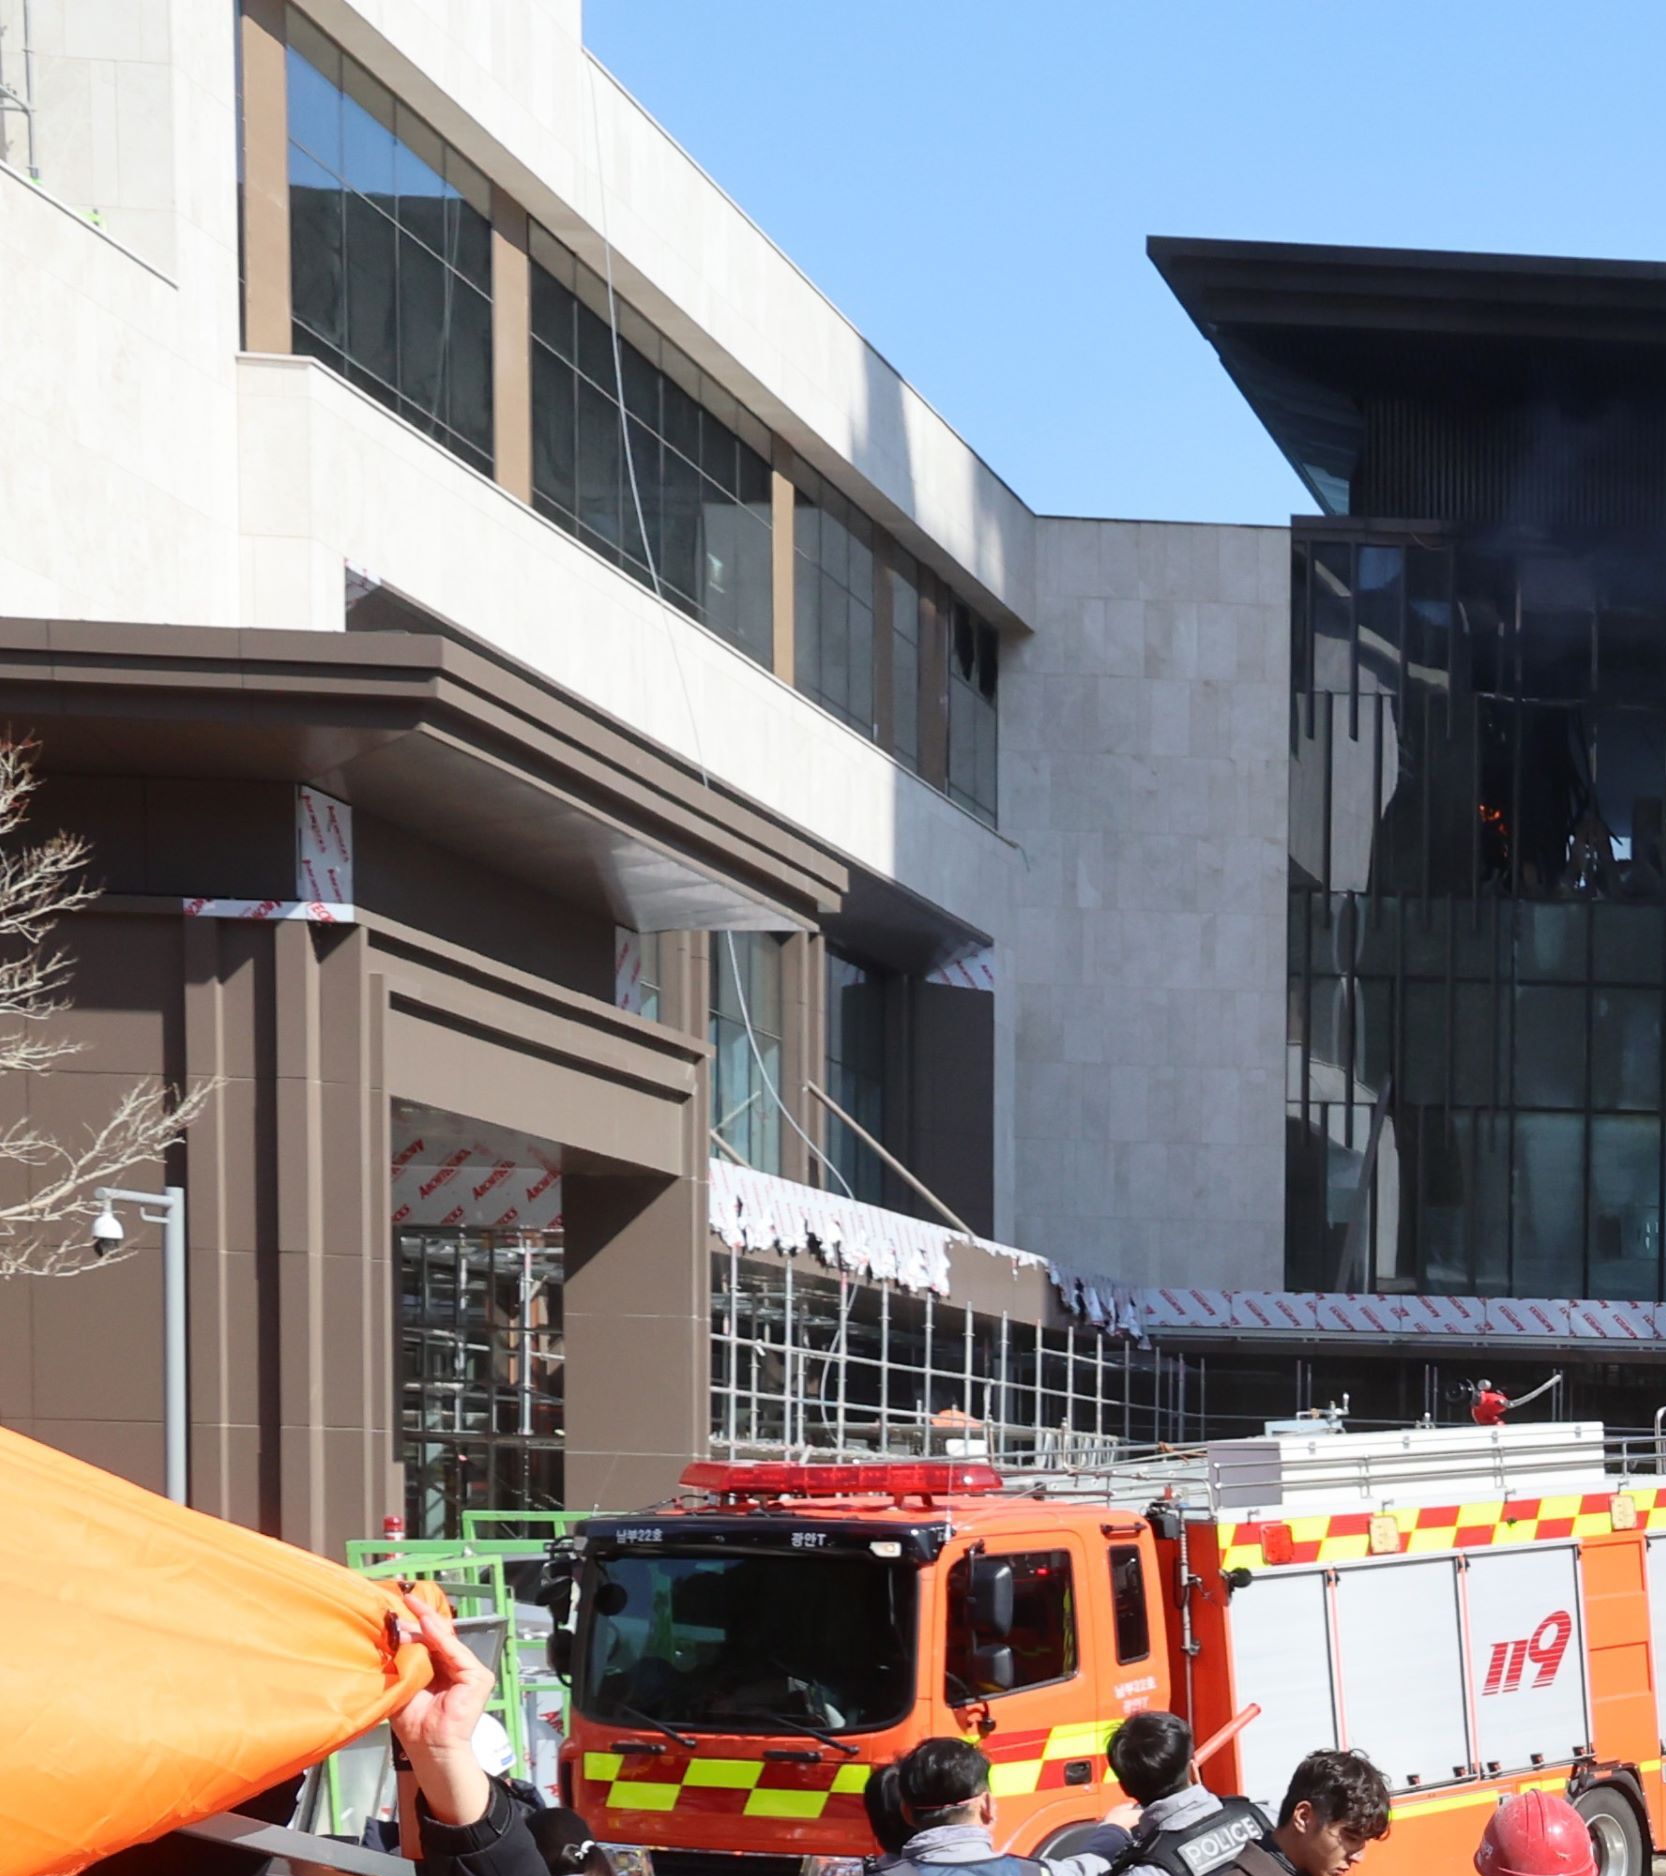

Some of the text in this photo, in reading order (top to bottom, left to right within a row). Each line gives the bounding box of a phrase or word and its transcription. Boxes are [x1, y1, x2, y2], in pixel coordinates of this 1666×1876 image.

[616, 1530, 664, 1544] 남부22호
[791, 1532, 827, 1548] 광안T
[1482, 1610, 1571, 1696] 119
[1183, 1816, 1265, 1864] POLICE
